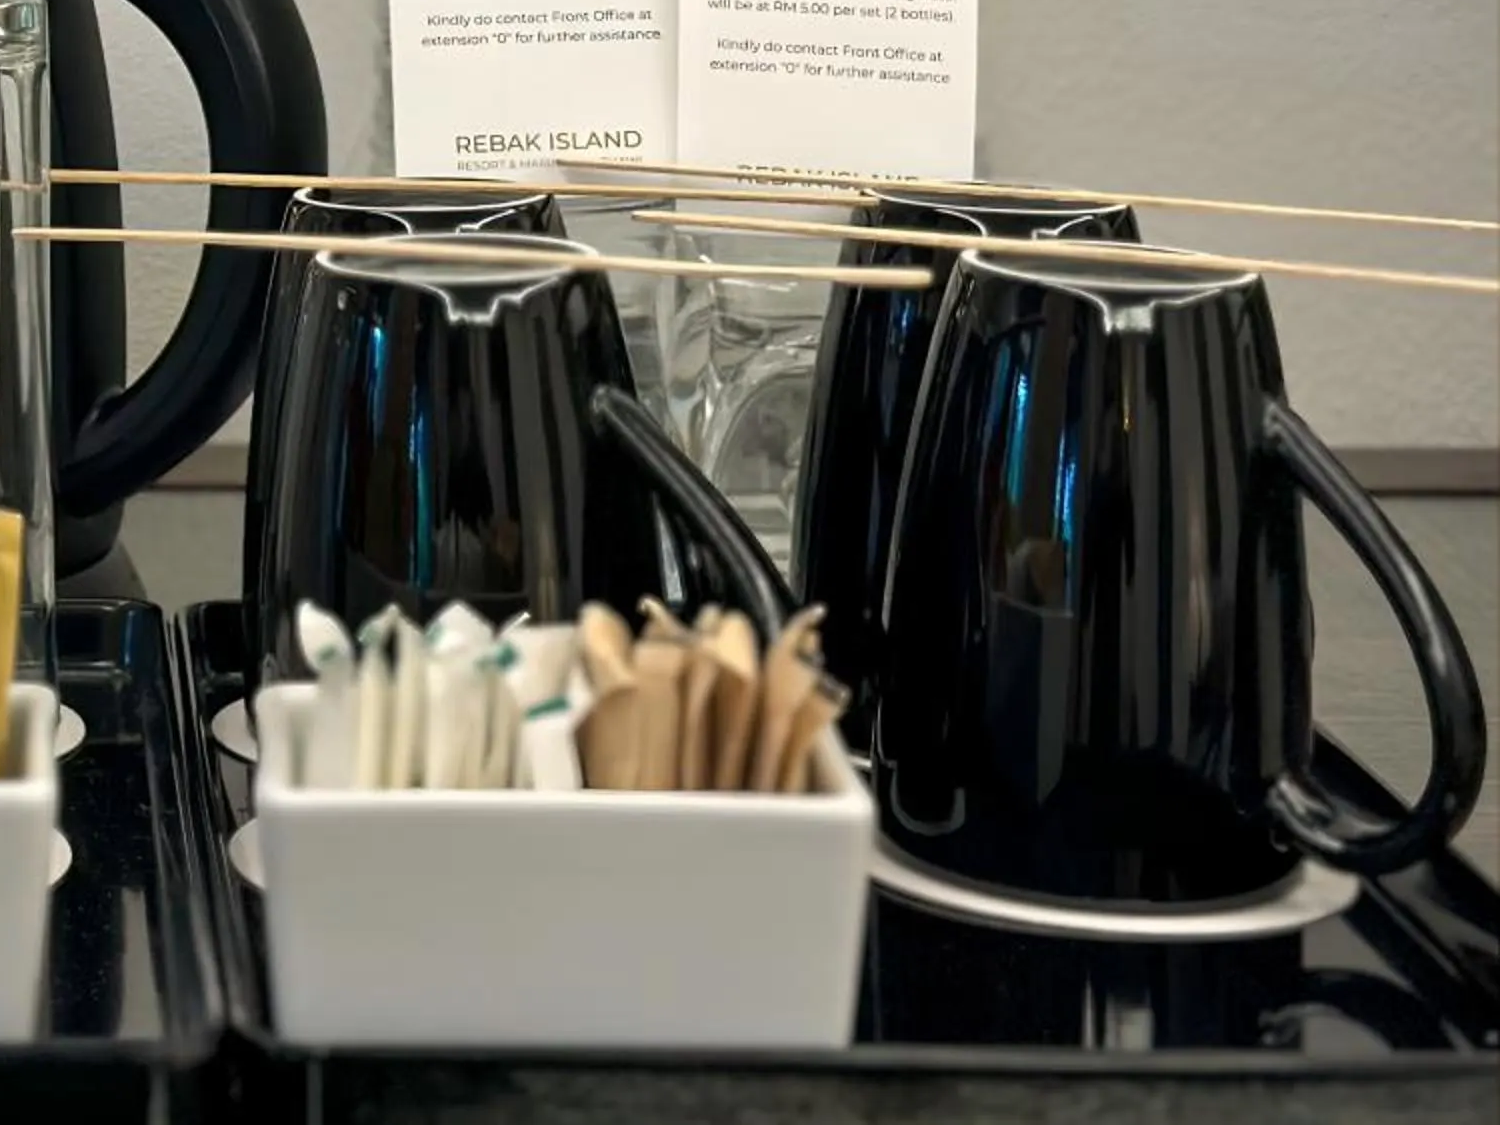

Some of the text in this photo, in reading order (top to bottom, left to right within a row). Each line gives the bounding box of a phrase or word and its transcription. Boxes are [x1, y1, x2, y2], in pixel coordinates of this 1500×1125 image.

[428, 9, 652, 28] Kindly do contact Front Office at
[735, 0, 753, 10] be
[756, 2, 770, 11] at
[774, 0, 797, 13] RM
[800, 2, 830, 15] 5.00
[833, 6, 855, 17] per
[860, 7, 881, 18] set
[885, 6, 897, 19] (2
[421, 35, 489, 46] extension
[492, 33, 512, 44] "0"
[515, 31, 533, 43] for
[537, 31, 586, 43] further
[718, 39, 942, 62] Kindly do contact Front Office at
[710, 60, 777, 72] extension
[779, 61, 800, 74] "0"
[804, 63, 823, 75] for
[826, 64, 875, 78] further
[456, 131, 642, 154] REBAK ISLAND
